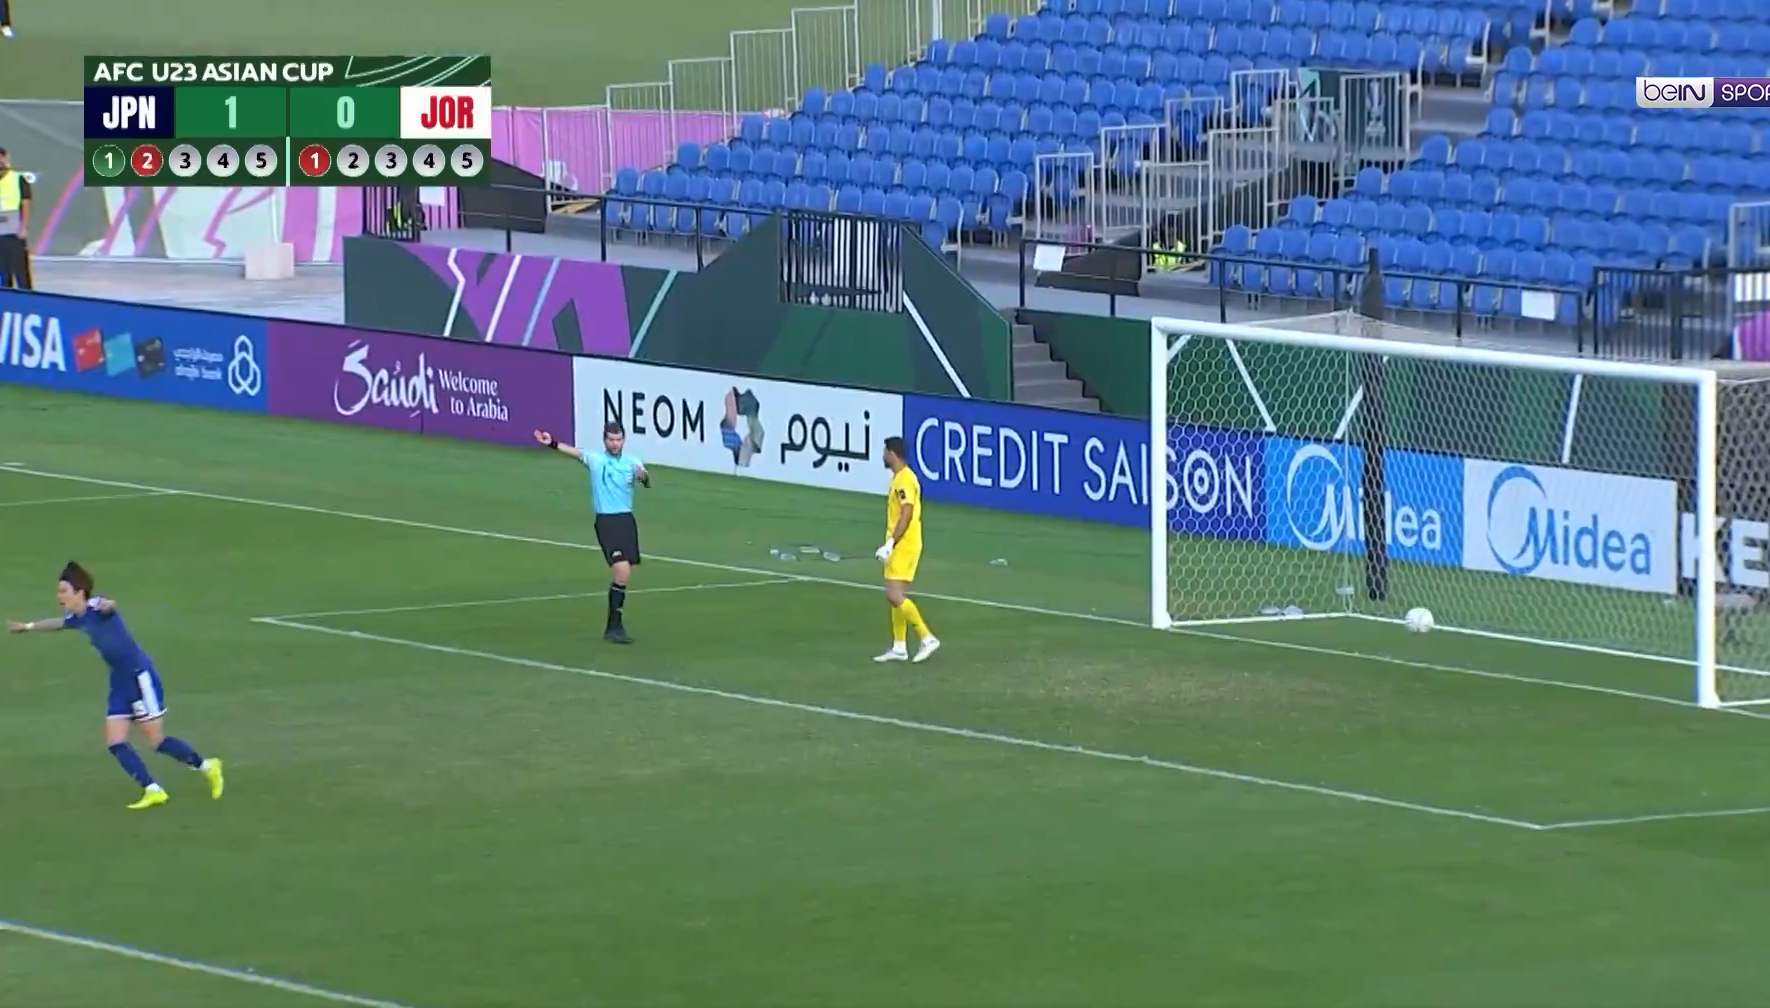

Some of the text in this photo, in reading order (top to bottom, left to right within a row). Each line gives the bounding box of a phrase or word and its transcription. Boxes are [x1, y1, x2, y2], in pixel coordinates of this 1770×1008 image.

[438, 368, 498, 396] Welcome
[450, 396, 509, 422] to Arabia
[603, 388, 705, 442] NEOM
[780, 410, 870, 472] نيوم
[915, 417, 1069, 495] CREDIT
[1286, 485, 1441, 550] Miea
[1487, 506, 1651, 575] Midea
